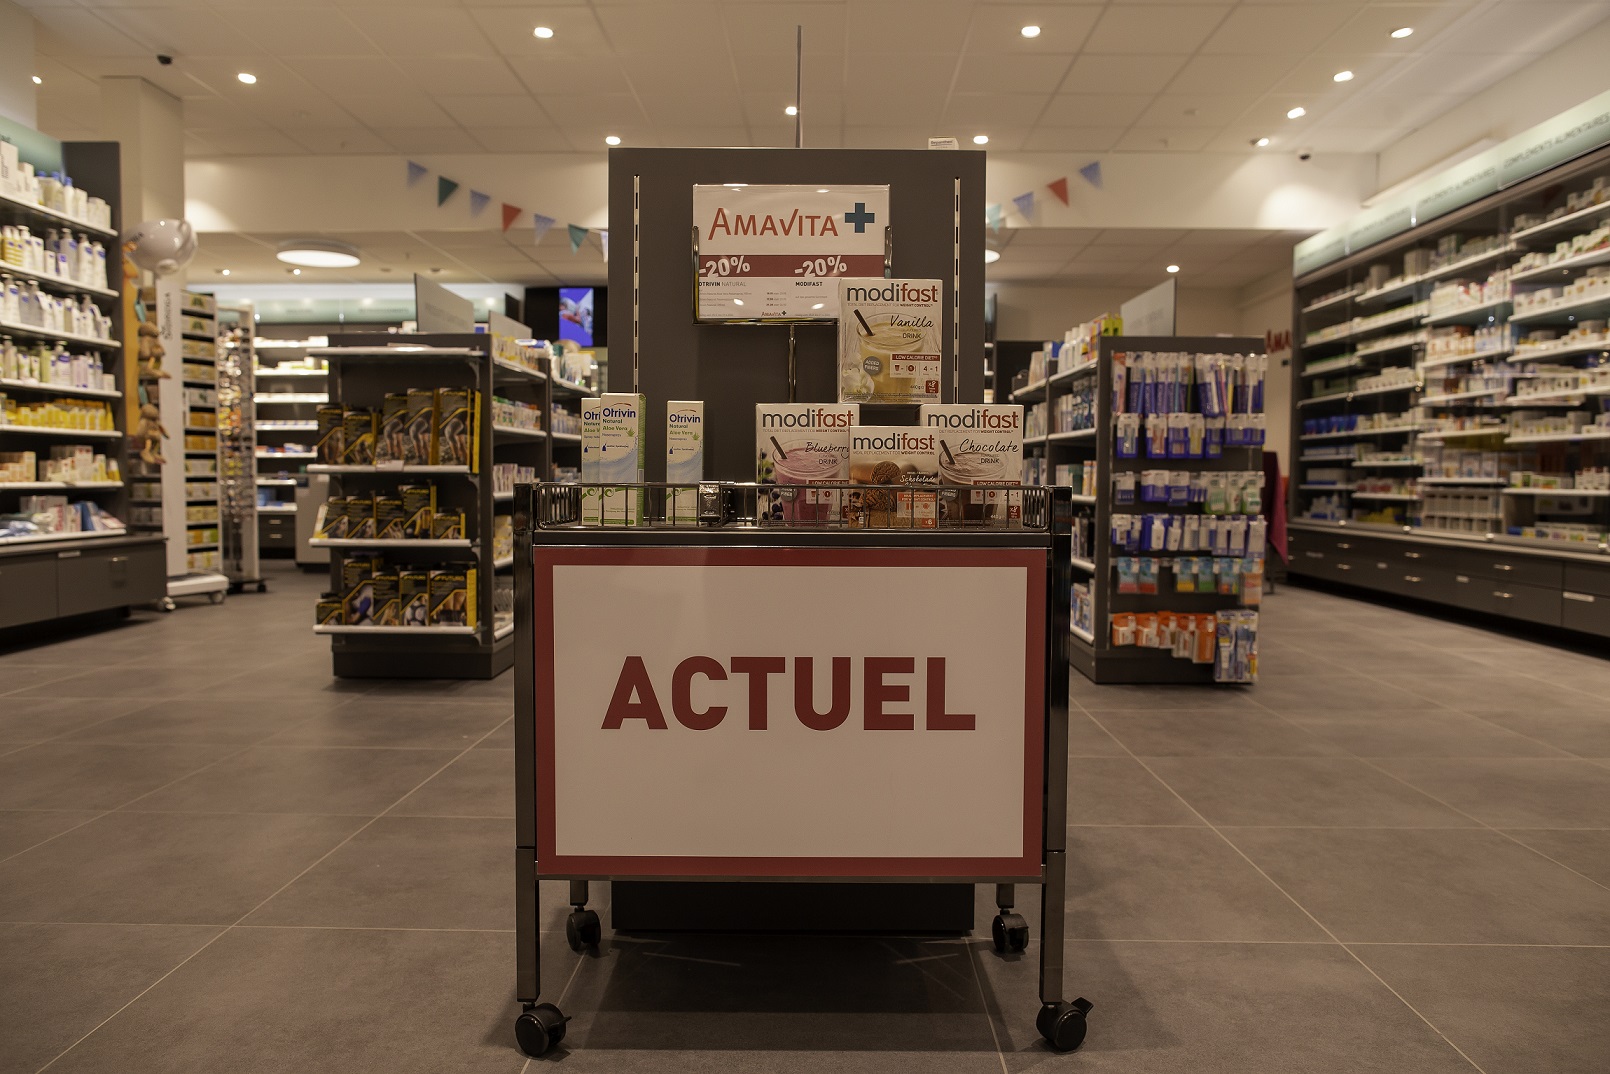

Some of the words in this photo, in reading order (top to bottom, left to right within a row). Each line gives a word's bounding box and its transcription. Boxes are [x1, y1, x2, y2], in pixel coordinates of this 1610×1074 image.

[708, 207, 839, 240] AMAVITA
[699, 255, 750, 278] -20%
[795, 255, 848, 278] -20%
[847, 282, 938, 303] modifast
[890, 314, 934, 328] Vanilla
[602, 407, 636, 418] Otrivin
[669, 413, 701, 423] Otrivin
[762, 408, 854, 427] modifast
[927, 409, 1019, 428] modifast
[805, 441, 849, 460] Blueberry
[853, 432, 935, 450] modifast
[959, 438, 1020, 453] Chocolate
[601, 655, 977, 731] ACTUEL
